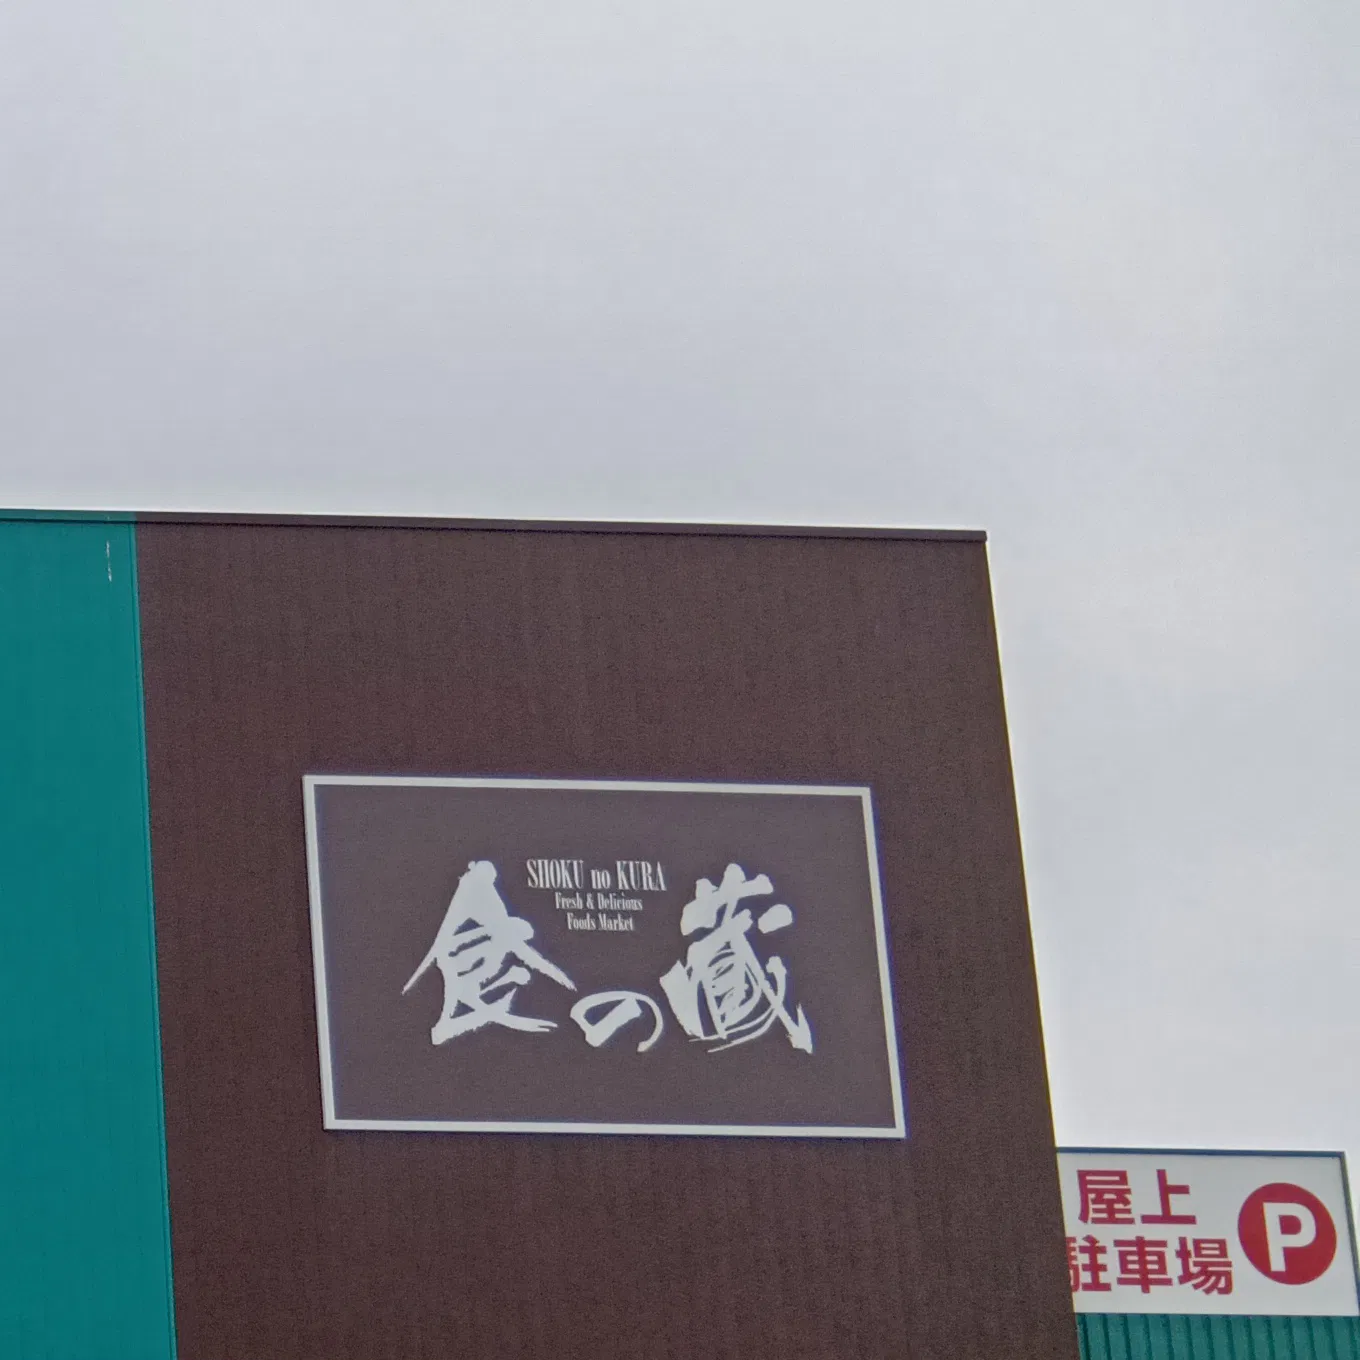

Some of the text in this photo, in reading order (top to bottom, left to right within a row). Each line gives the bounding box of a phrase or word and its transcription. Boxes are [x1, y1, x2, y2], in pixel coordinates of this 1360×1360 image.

[526, 858, 667, 892] SHOKU no KURA
[555, 892, 643, 911] Fresh & Delicious
[567, 912, 635, 931] Foods Market
[401, 860, 814, 1054] 食の蔵
[1076, 1168, 1197, 1225] 屋上
[1065, 1234, 1234, 1296] 駐車場
[1262, 1202, 1317, 1272] P
